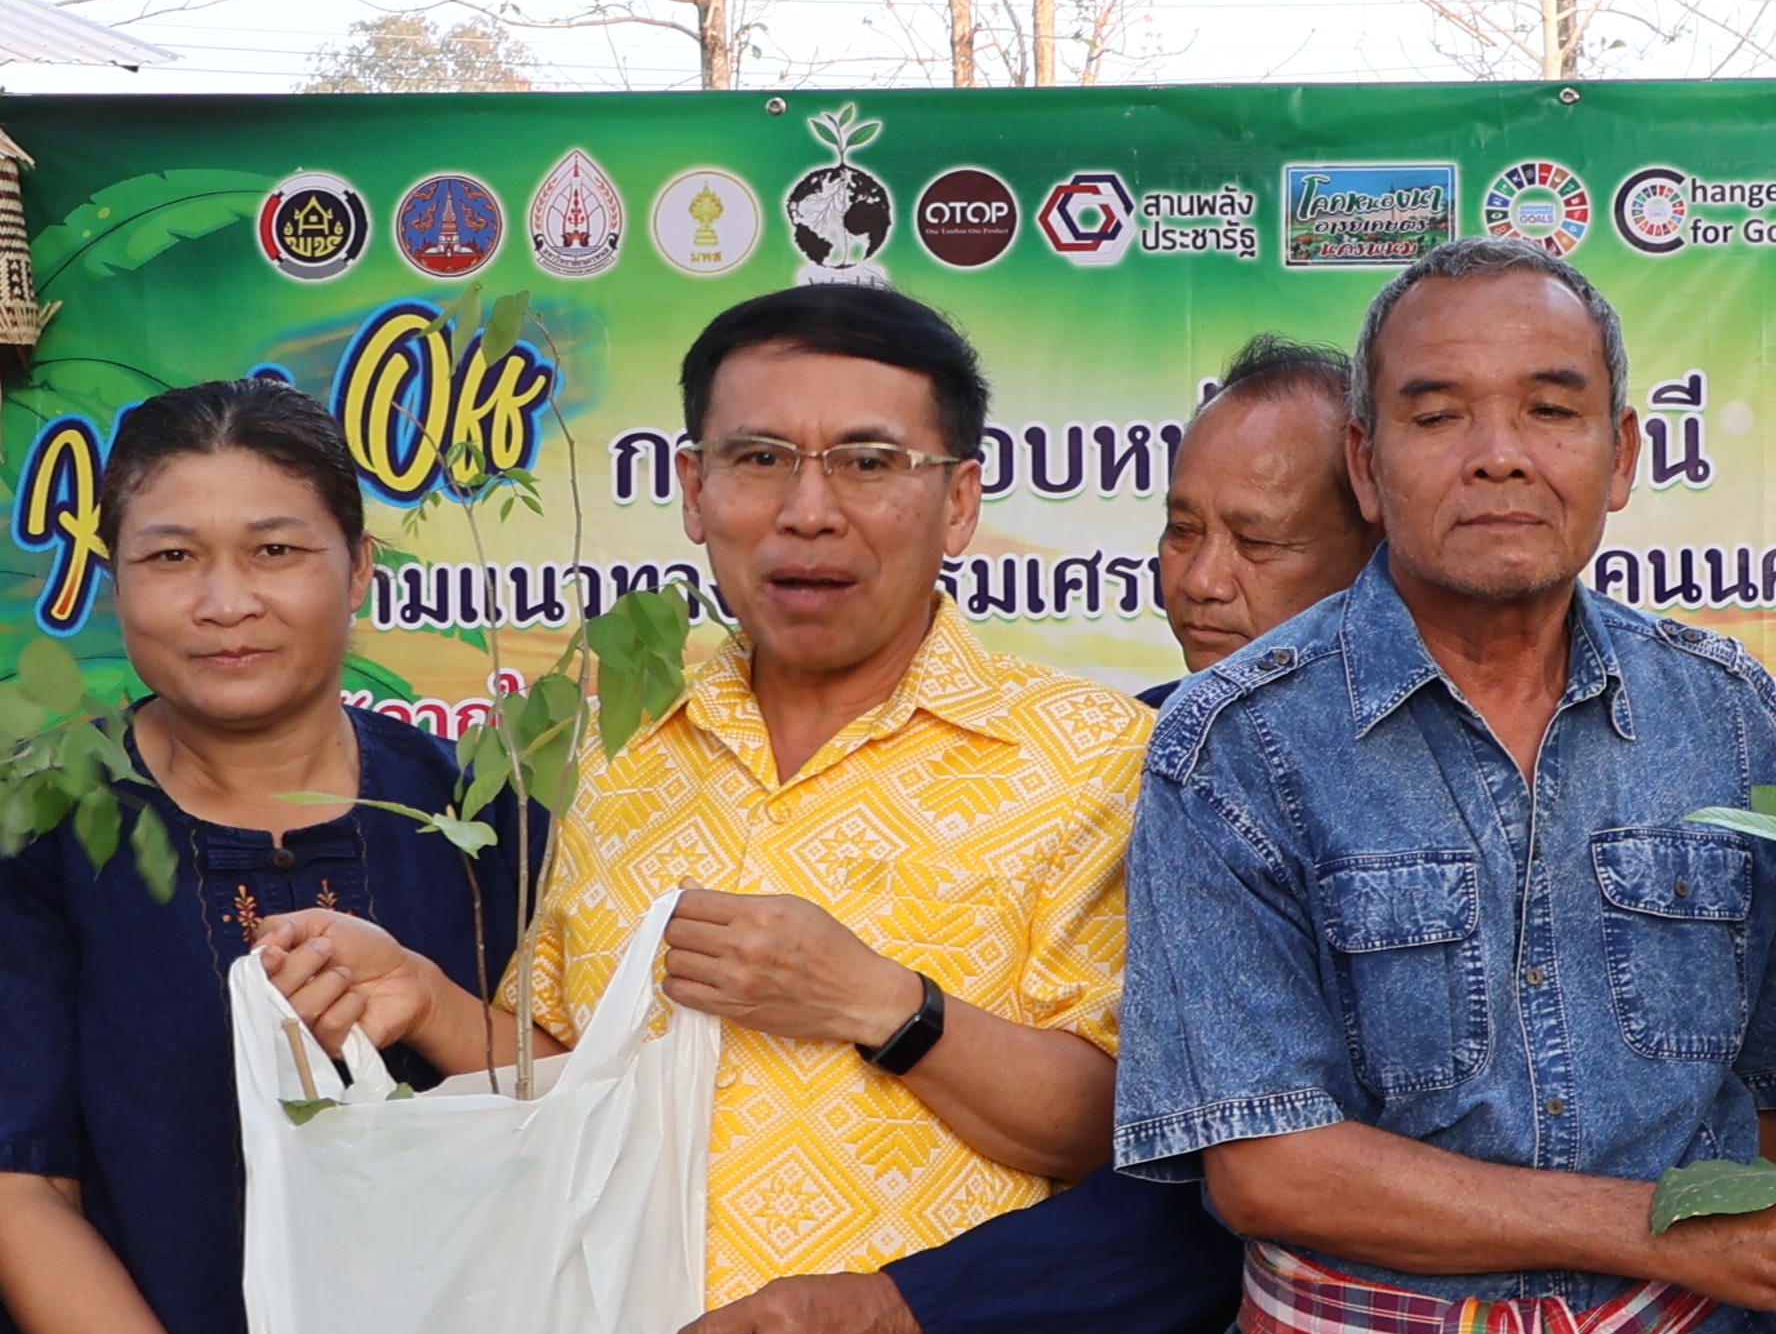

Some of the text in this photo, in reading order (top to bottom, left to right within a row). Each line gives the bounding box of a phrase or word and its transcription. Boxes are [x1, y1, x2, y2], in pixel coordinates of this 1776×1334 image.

[1142, 185, 1254, 218] สานพลัง
[1297, 174, 1443, 221] โคกหนองนา
[925, 201, 1009, 224] OTOP
[1142, 220, 1256, 258] ประชารัฐ
[1690, 218, 1734, 244] for
[1319, 241, 1419, 257] นครพนม
